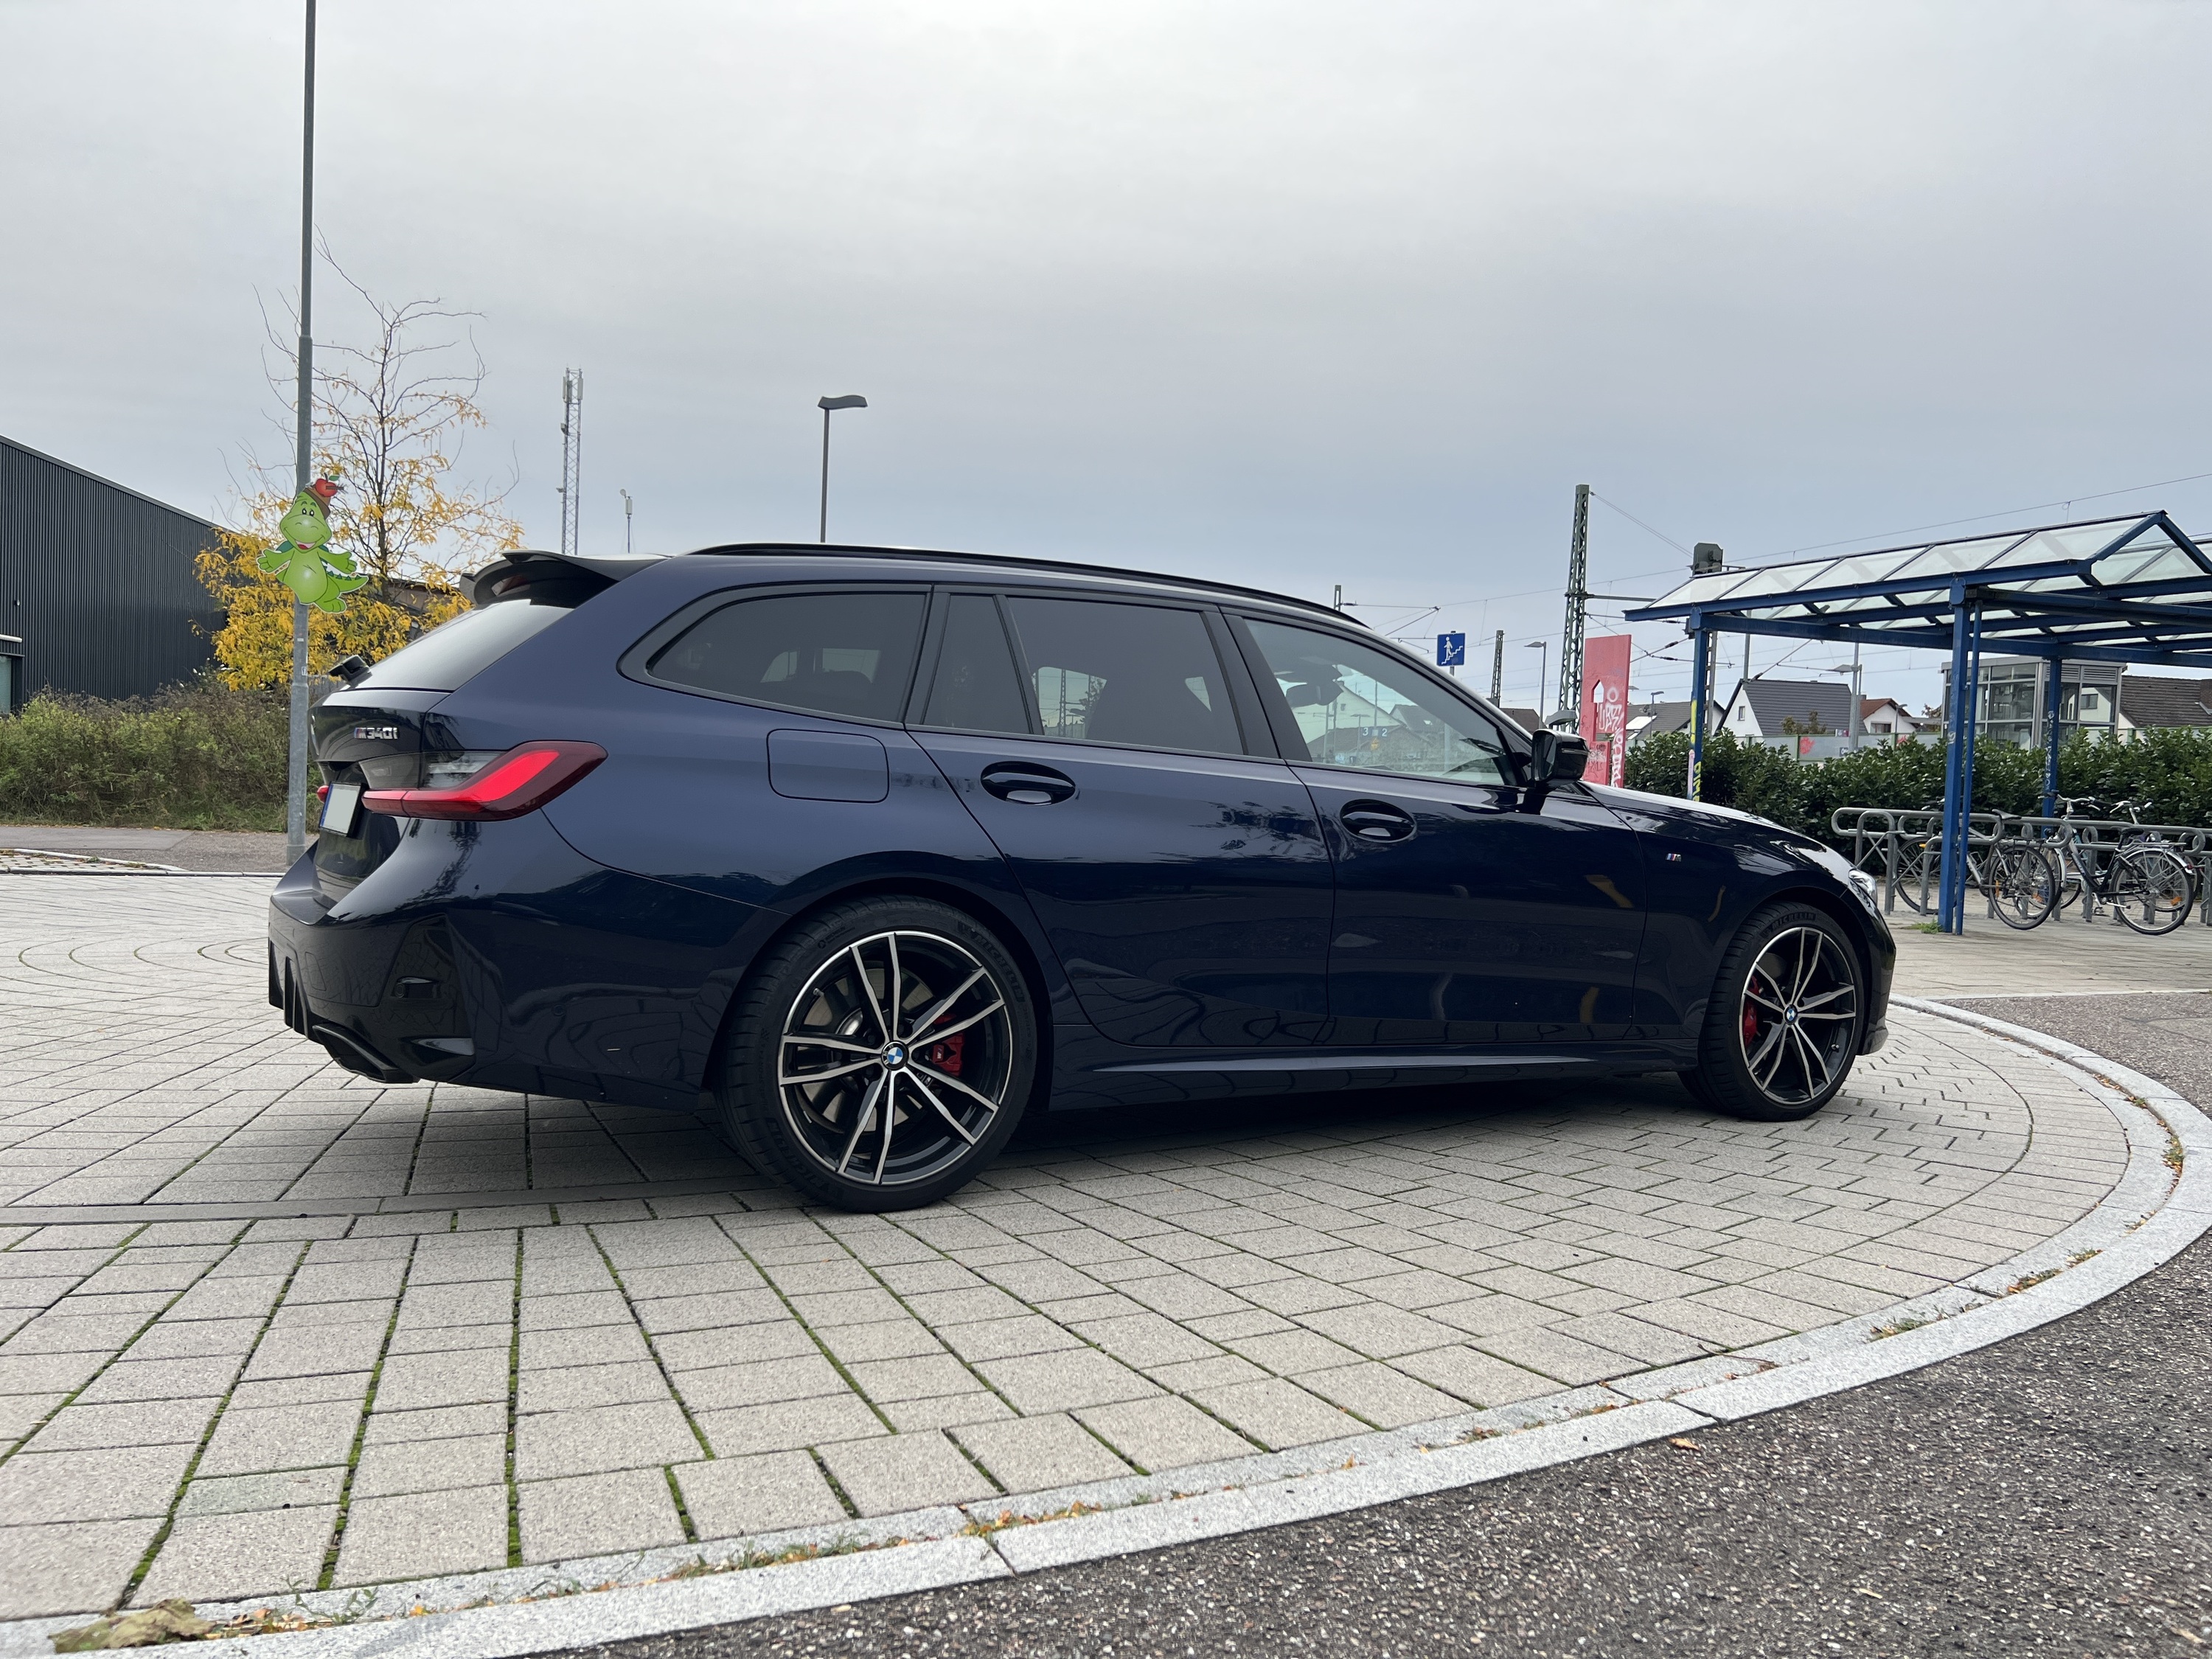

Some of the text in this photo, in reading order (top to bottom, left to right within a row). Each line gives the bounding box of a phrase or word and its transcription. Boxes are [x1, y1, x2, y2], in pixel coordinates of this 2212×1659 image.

[1362, 727, 1388, 737] 3 2
[1770, 912, 1817, 931] MICHELIN
